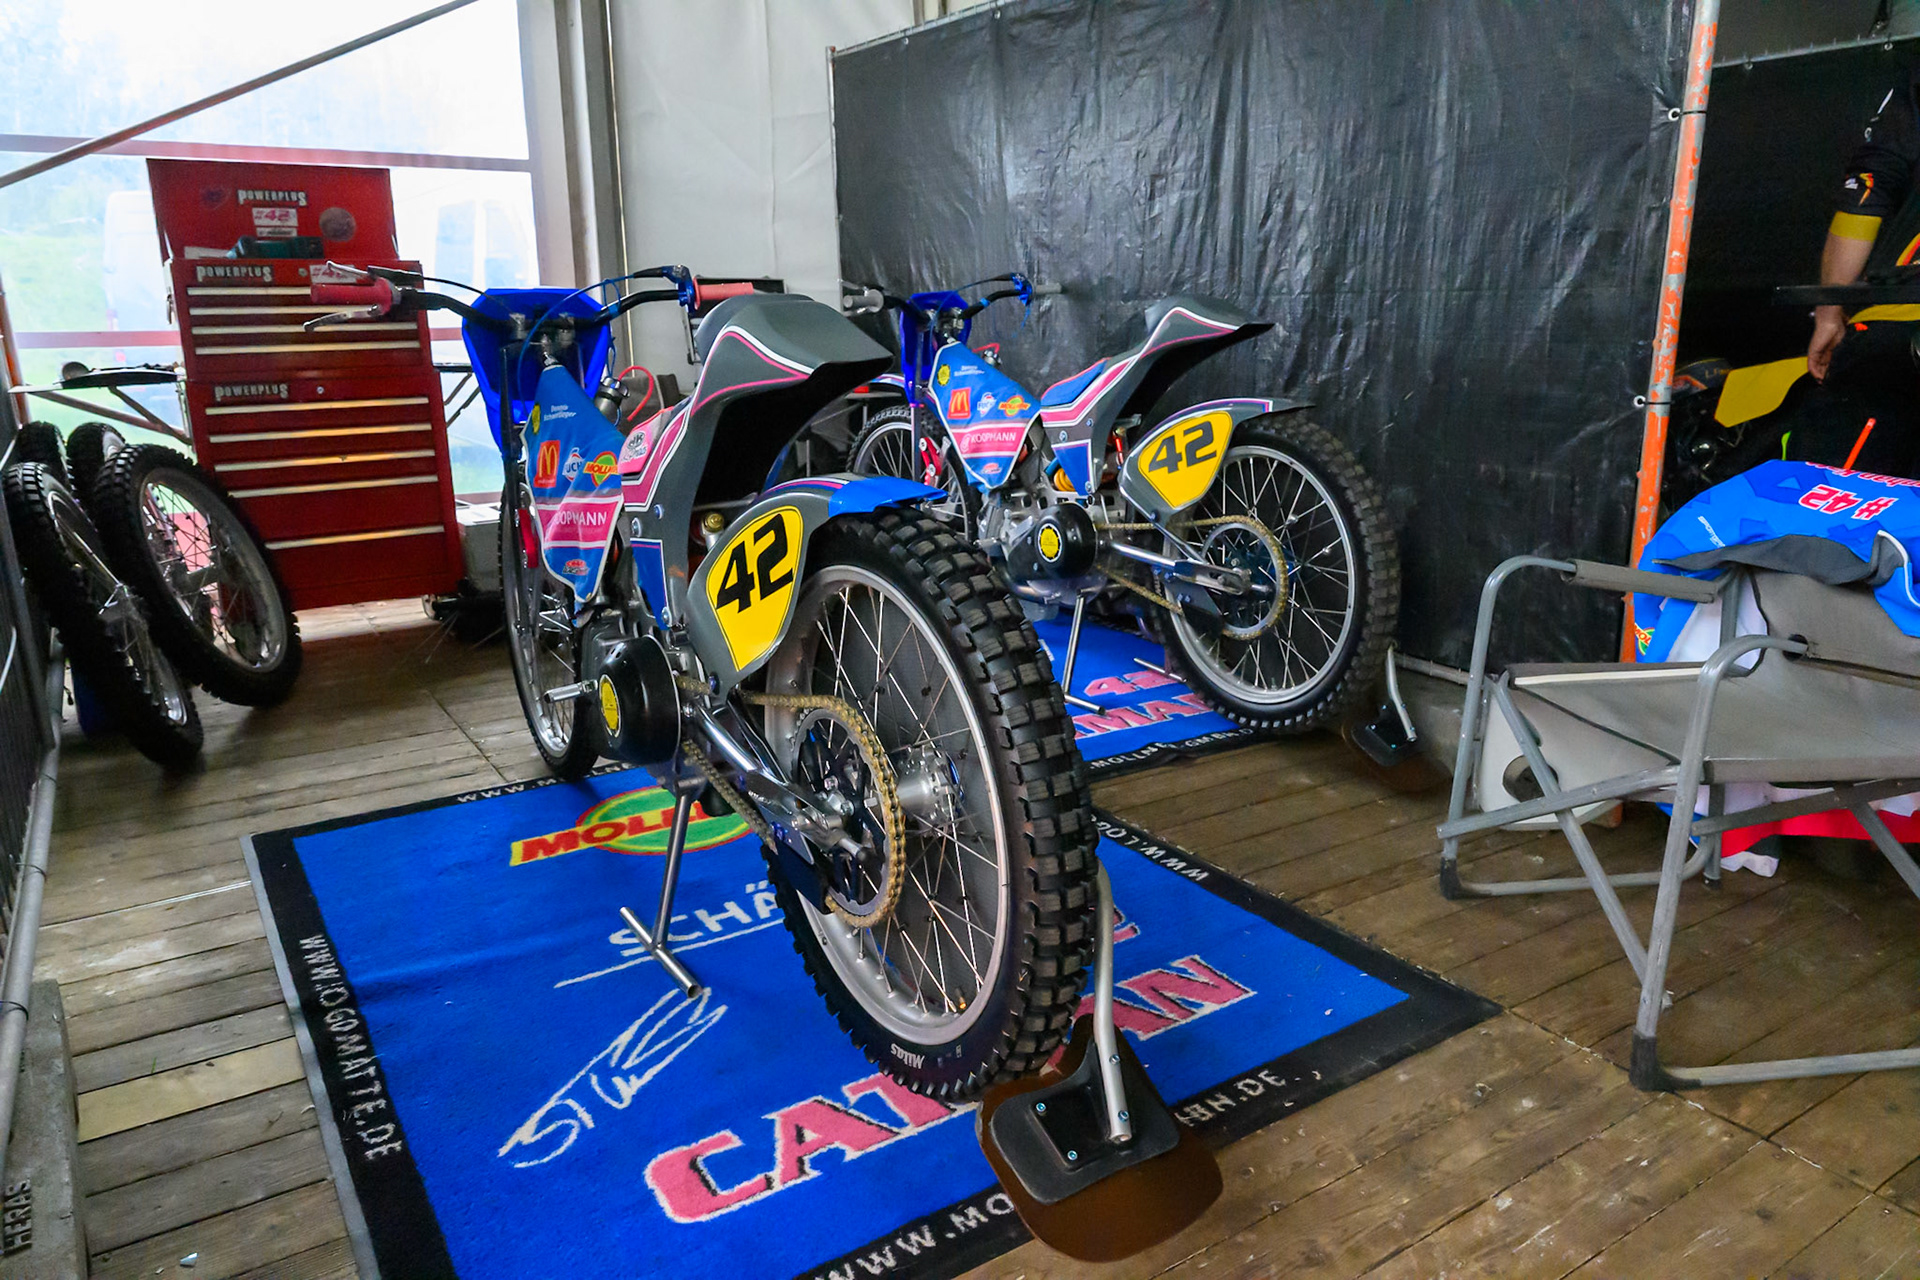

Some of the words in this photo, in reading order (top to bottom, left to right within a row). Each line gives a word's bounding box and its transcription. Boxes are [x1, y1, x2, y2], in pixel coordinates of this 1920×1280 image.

[237, 189, 307, 206] POWERPLUS
[196, 266, 273, 282] POWERPLUS
[215, 383, 289, 402] POWERPLUS
[1148, 420, 1217, 474] 42
[1798, 484, 1863, 514] 42
[715, 513, 794, 613] 42
[890, 1043, 926, 1070] Mitas
[4, 1180, 32, 1254] HERAS
